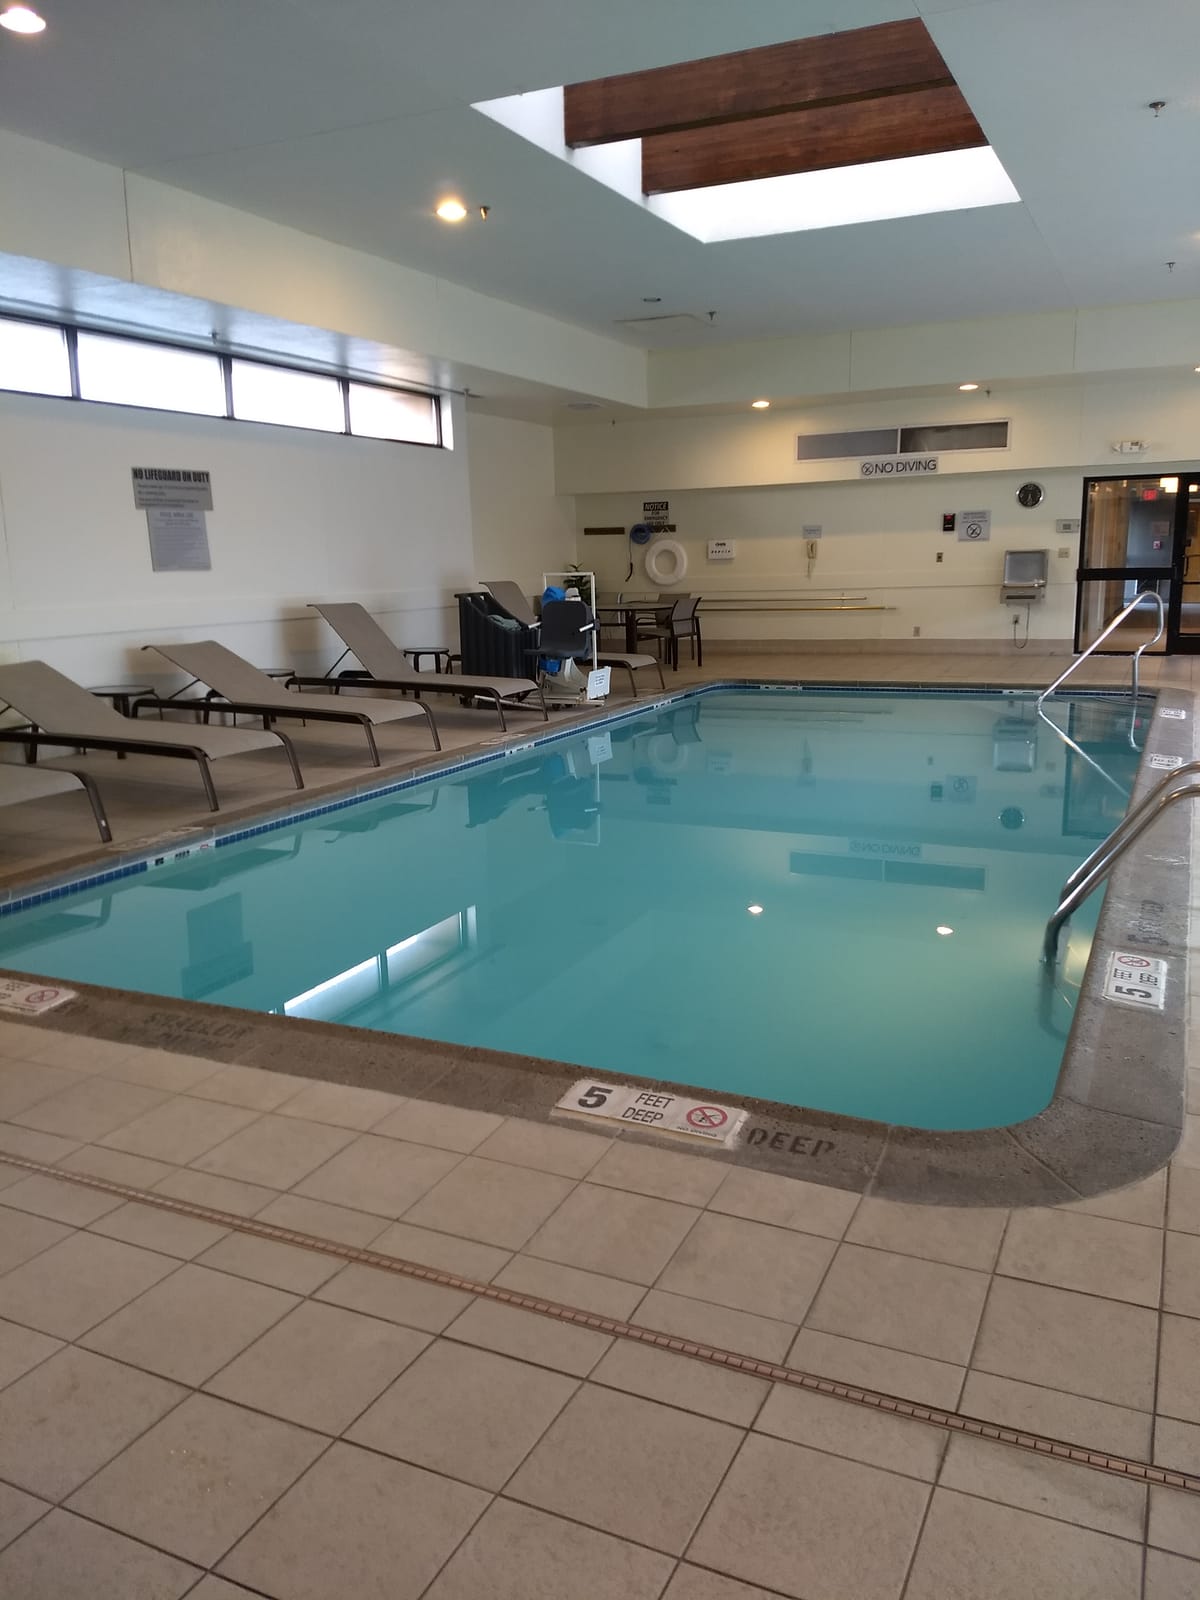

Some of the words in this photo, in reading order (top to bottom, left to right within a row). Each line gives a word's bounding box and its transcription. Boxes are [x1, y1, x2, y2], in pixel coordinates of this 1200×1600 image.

[875, 463, 894, 474] NO
[896, 460, 937, 472] DIVING
[133, 468, 143, 480] NO
[144, 468, 182, 481] LIFEGUARD
[182, 471, 192, 482] ON
[192, 472, 209, 483] DUTY
[1115, 986, 1152, 999] 5
[578, 1086, 613, 1109] 5
[635, 1093, 675, 1109] FEET
[622, 1107, 664, 1124] DEEP
[747, 1128, 835, 1157] DEEP
